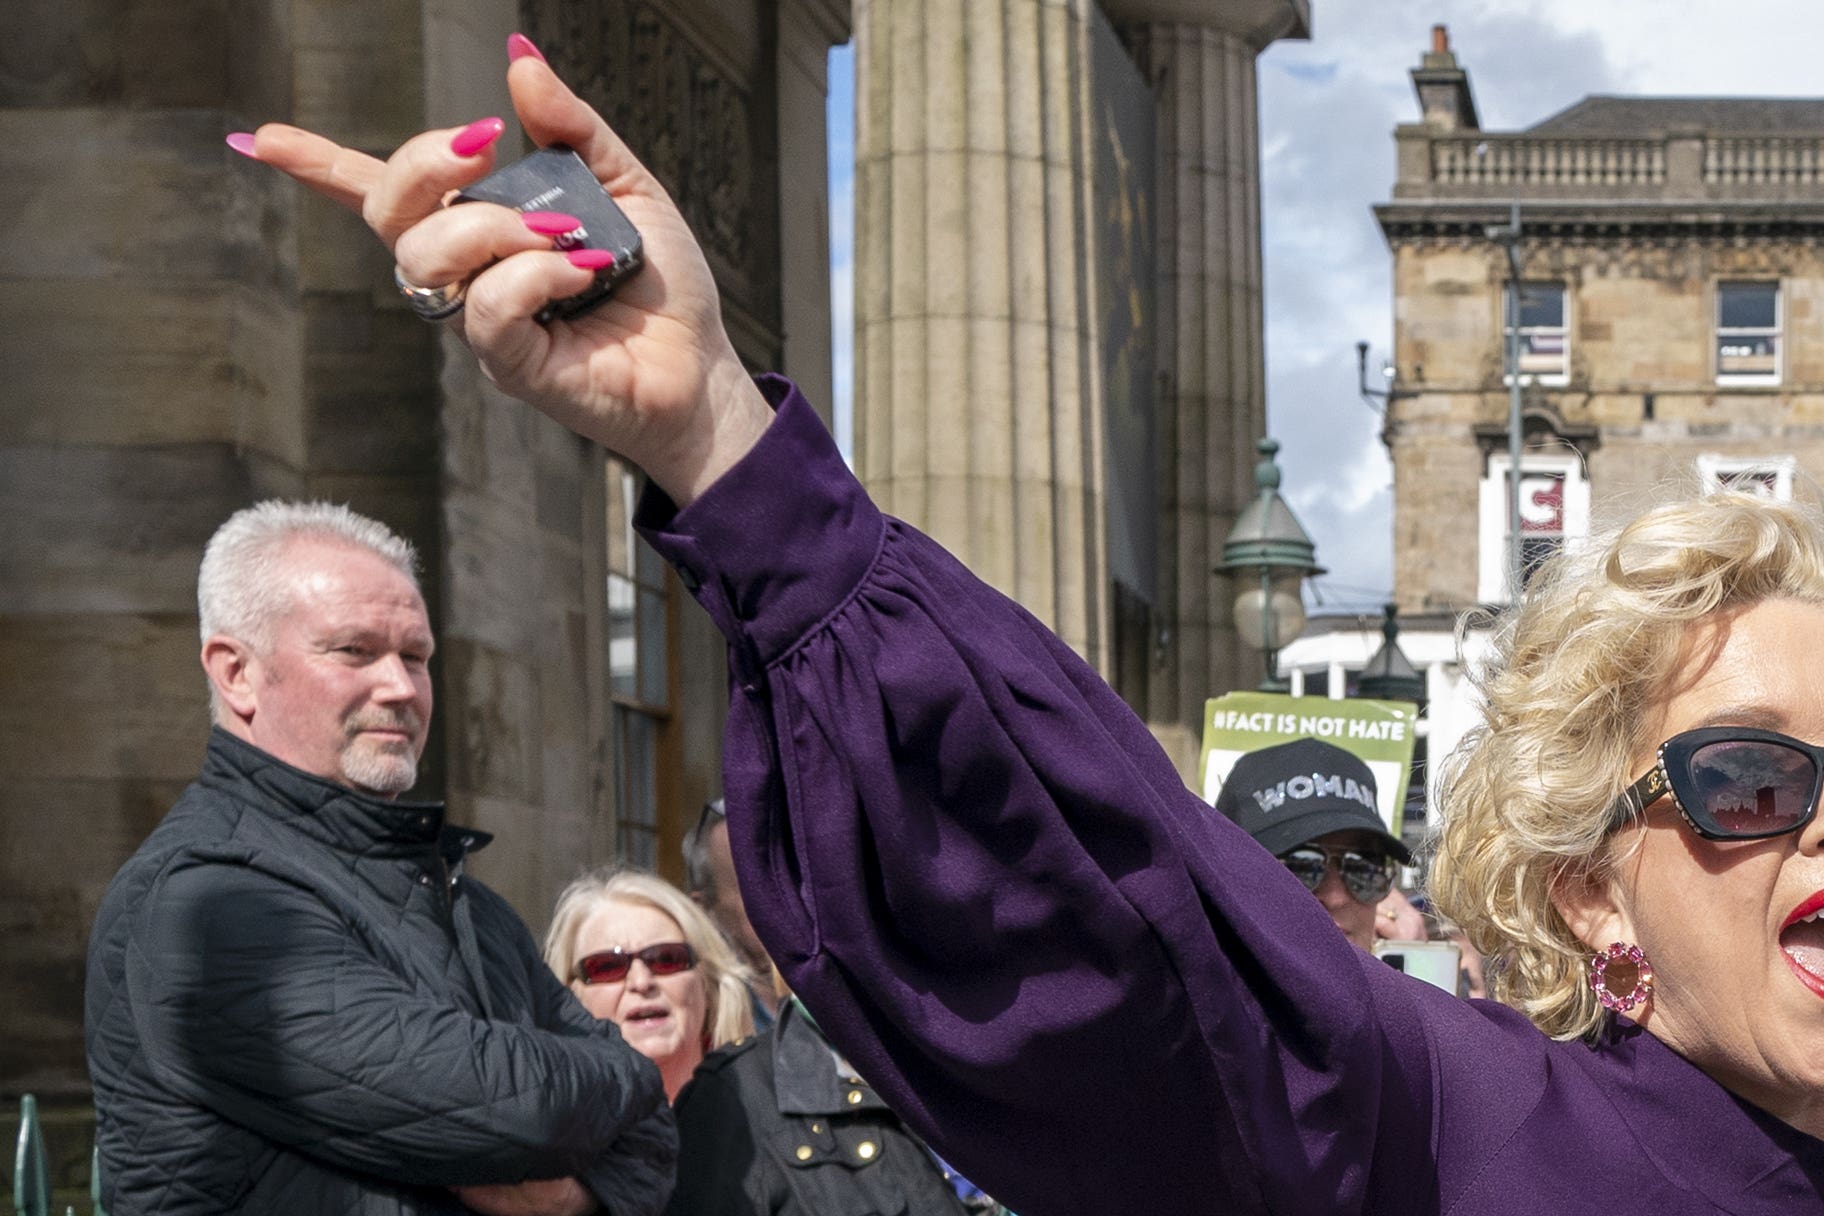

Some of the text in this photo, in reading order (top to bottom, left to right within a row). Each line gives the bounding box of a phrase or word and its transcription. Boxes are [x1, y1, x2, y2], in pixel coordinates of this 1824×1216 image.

[1213, 710, 1405, 742] #FACT IS NOT HATE
[1252, 772, 1378, 814] WOMAN
